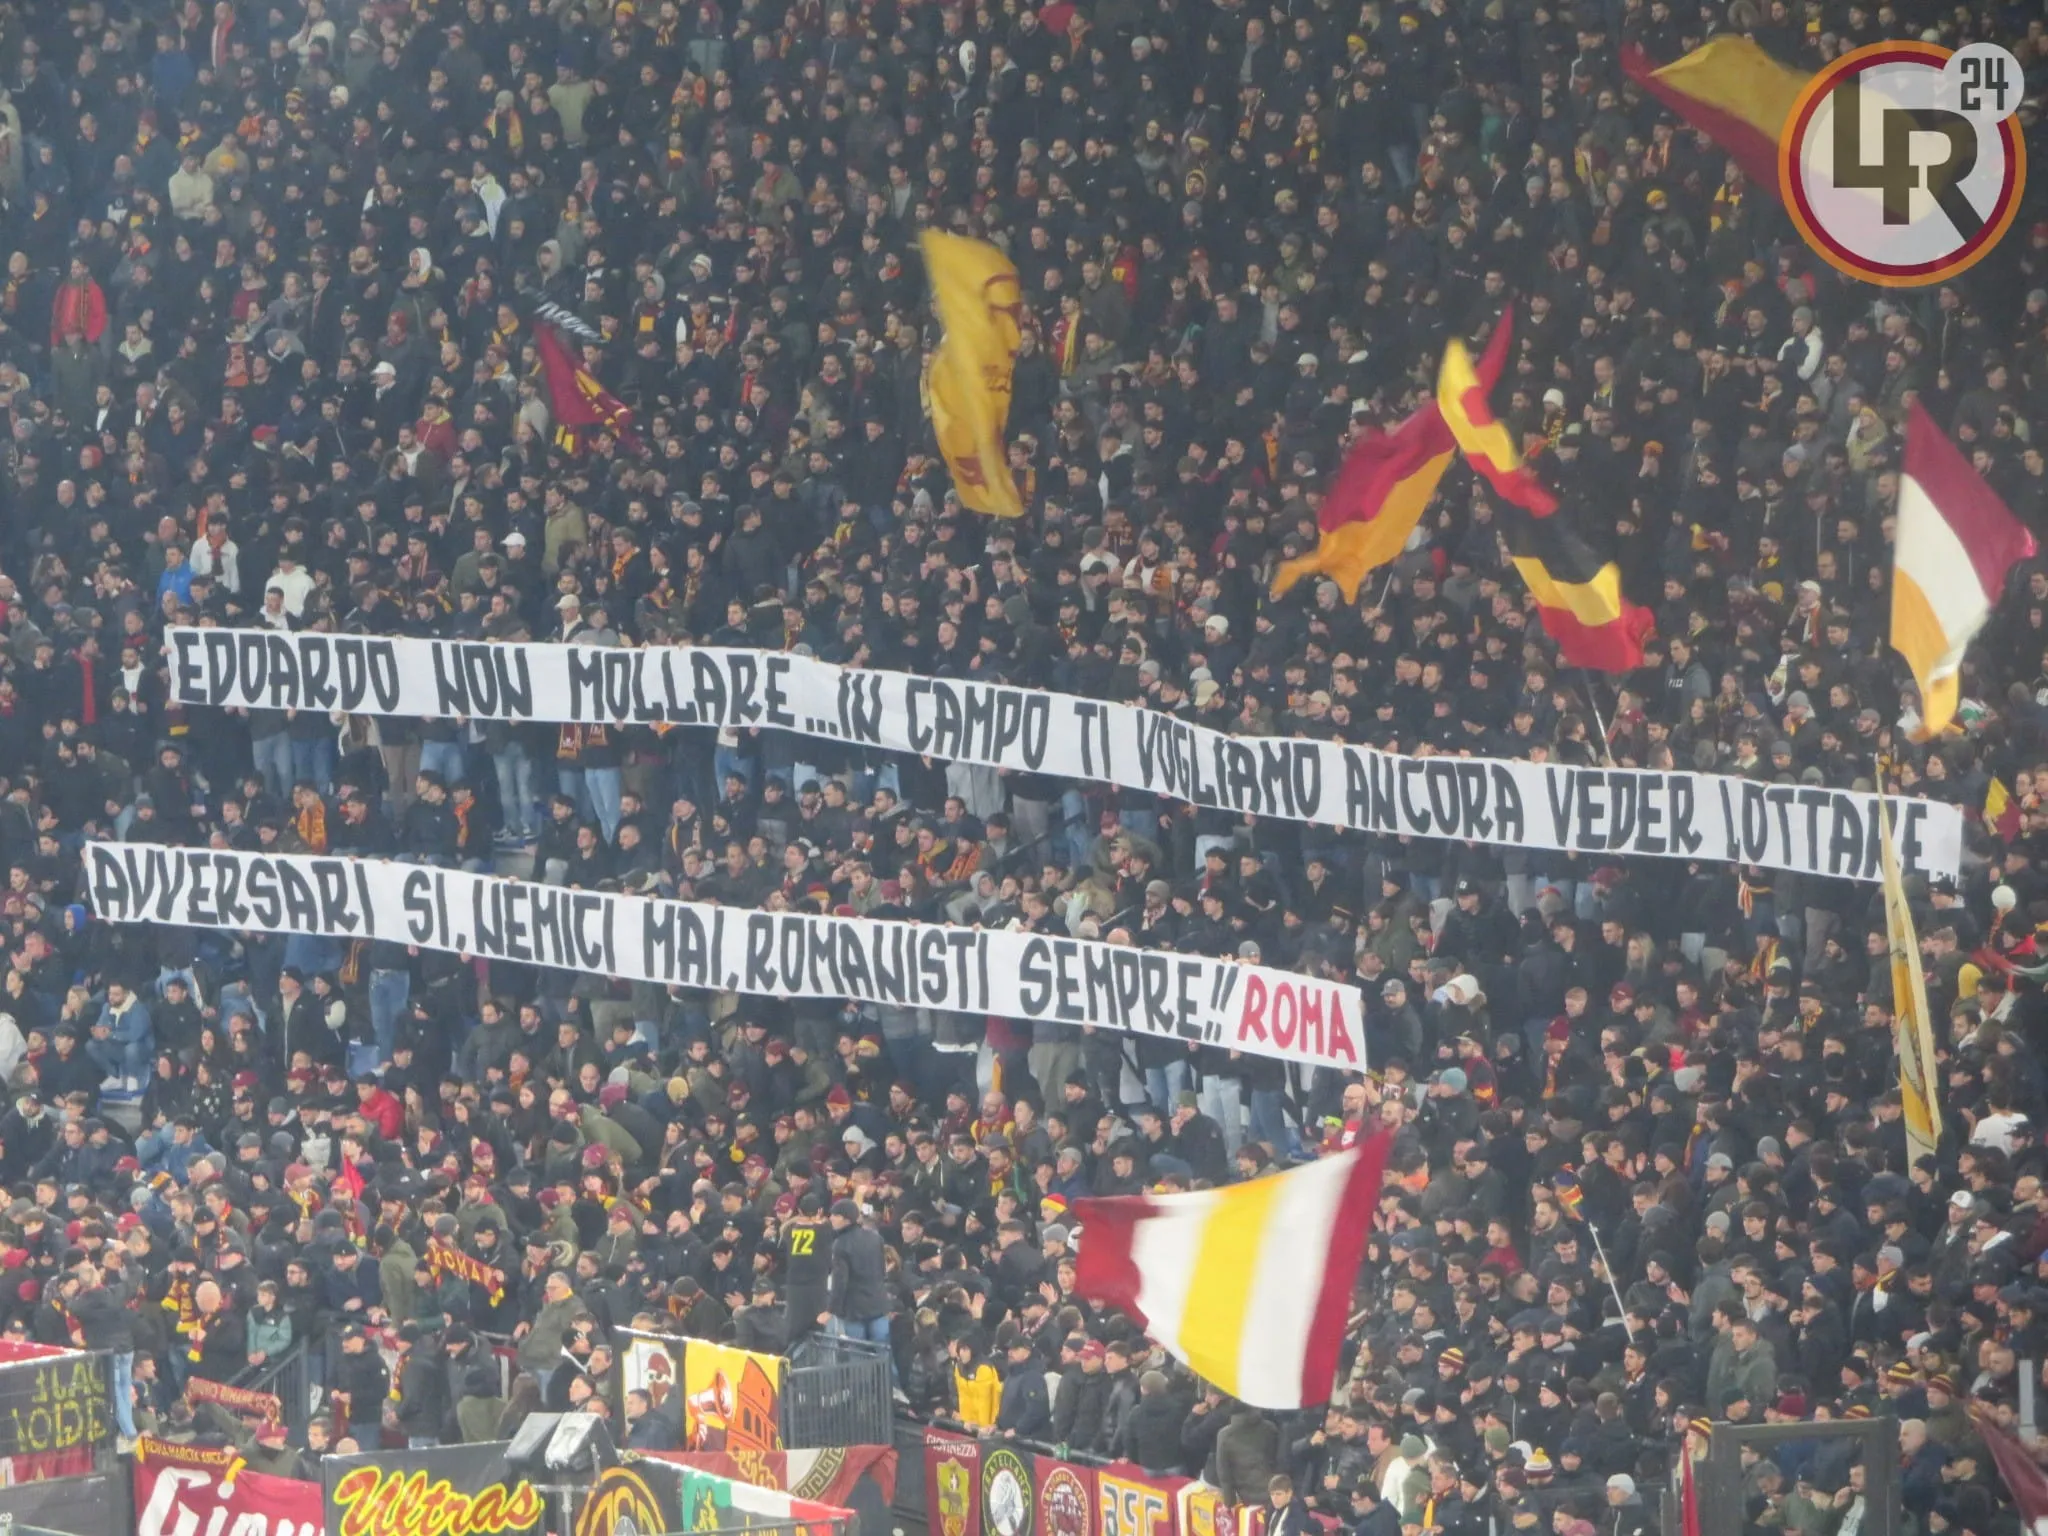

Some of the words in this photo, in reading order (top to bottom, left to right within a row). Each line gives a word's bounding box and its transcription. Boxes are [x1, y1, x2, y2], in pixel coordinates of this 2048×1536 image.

[172, 631, 400, 713] EDOARDO
[432, 641, 534, 717] NON
[906, 676, 1051, 770] CAMPO
[1073, 702, 1111, 779] TI
[1135, 710, 1321, 818] VOGLIAMO
[1344, 746, 1525, 842] ANCORA
[1546, 766, 1704, 854] VEDER
[91, 846, 376, 936] AVVERSARI
[1237, 973, 1357, 1064] ROMA
[791, 1228, 815, 1255] 72
[333, 1465, 545, 1536] Ultras
